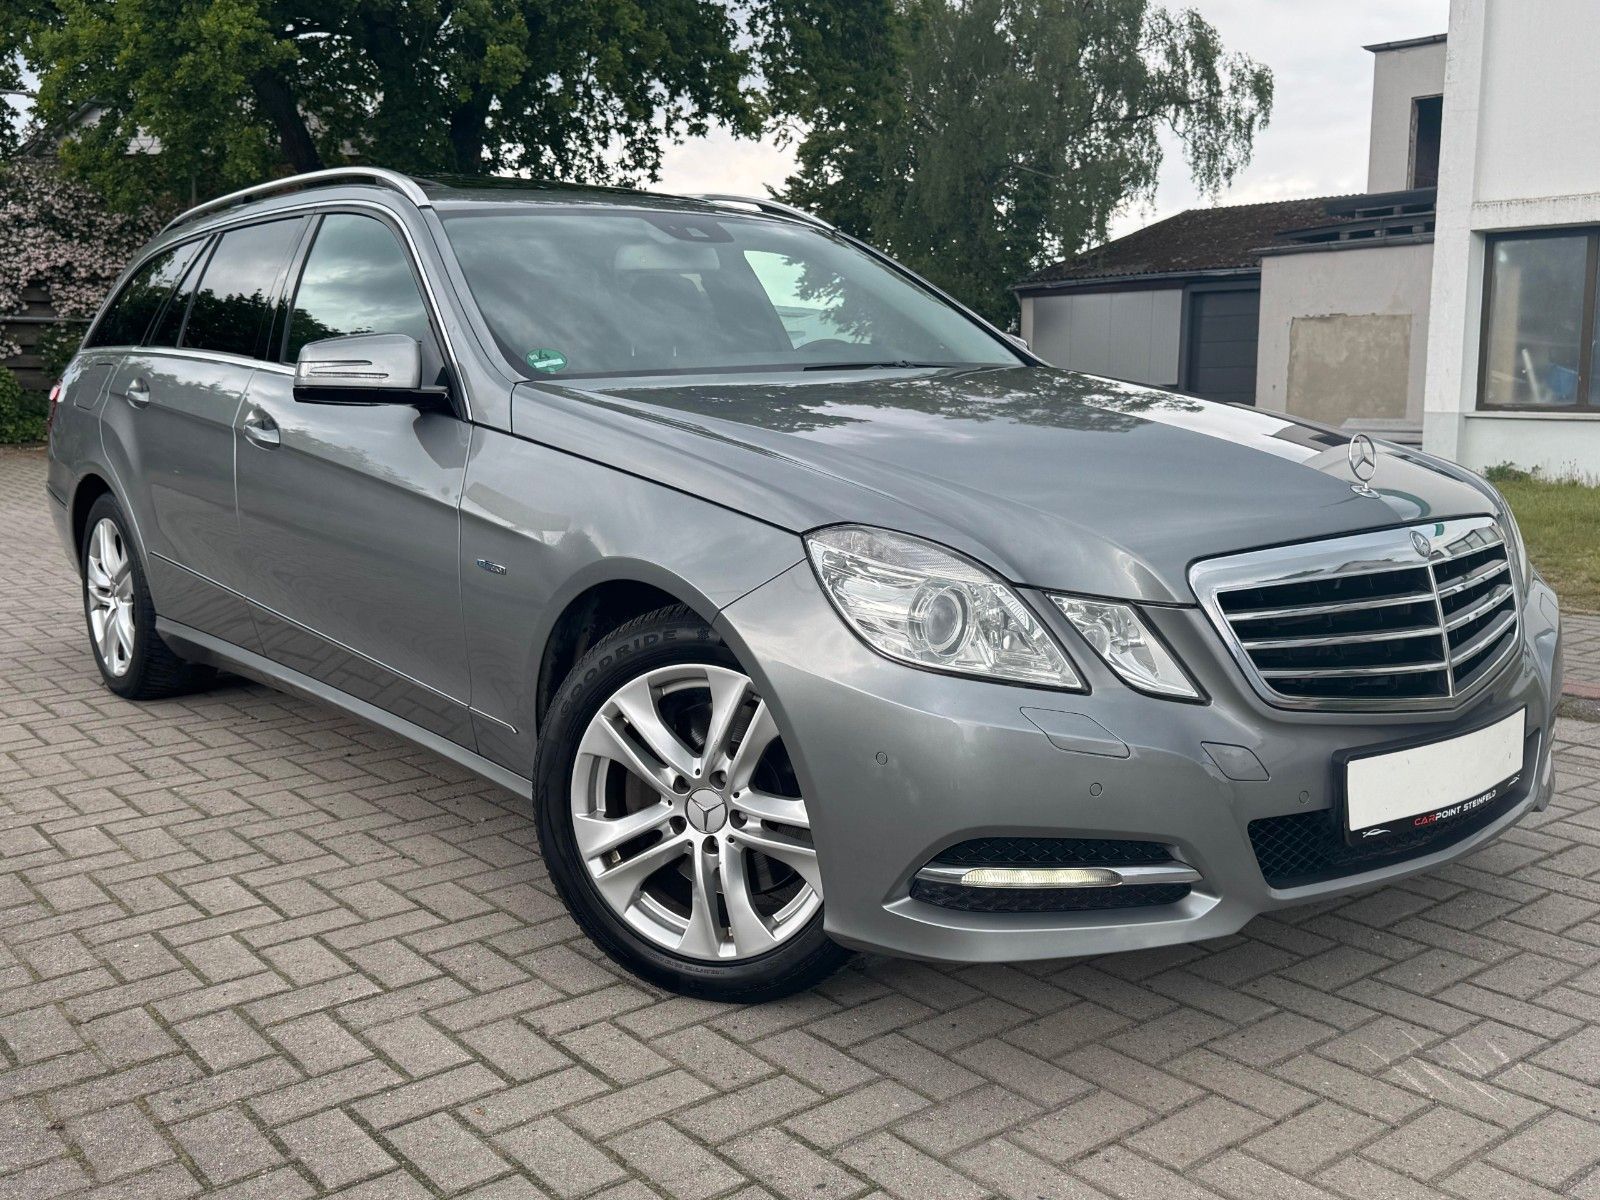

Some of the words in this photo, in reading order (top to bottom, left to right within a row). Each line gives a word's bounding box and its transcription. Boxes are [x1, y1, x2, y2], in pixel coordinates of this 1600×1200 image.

[560, 629, 678, 714] GOODRIDE
[1414, 805, 1462, 826] CARPOINT
[1463, 789, 1497, 812] STEINFELD
